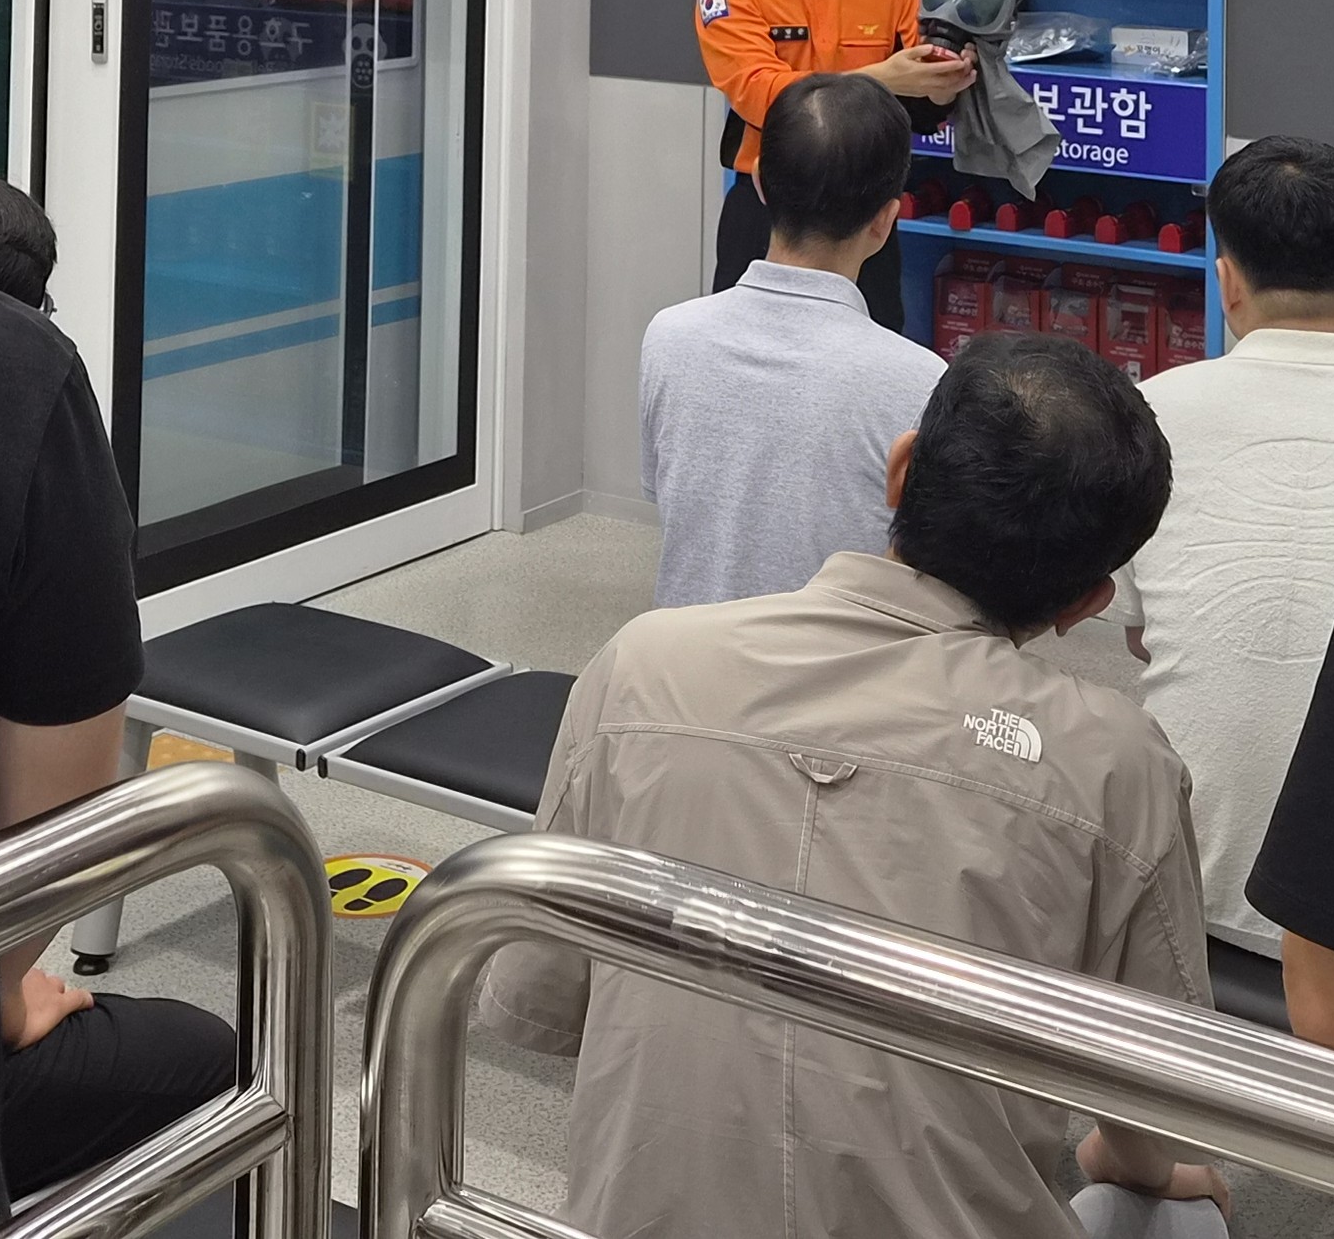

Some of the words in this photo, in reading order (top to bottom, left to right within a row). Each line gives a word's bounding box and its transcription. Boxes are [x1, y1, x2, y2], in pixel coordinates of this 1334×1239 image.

[1033, 83, 1152, 139] 보관함
[963, 714, 1017, 741] NORTH
[991, 708, 1019, 728] THE
[976, 731, 1015, 755] FACE
